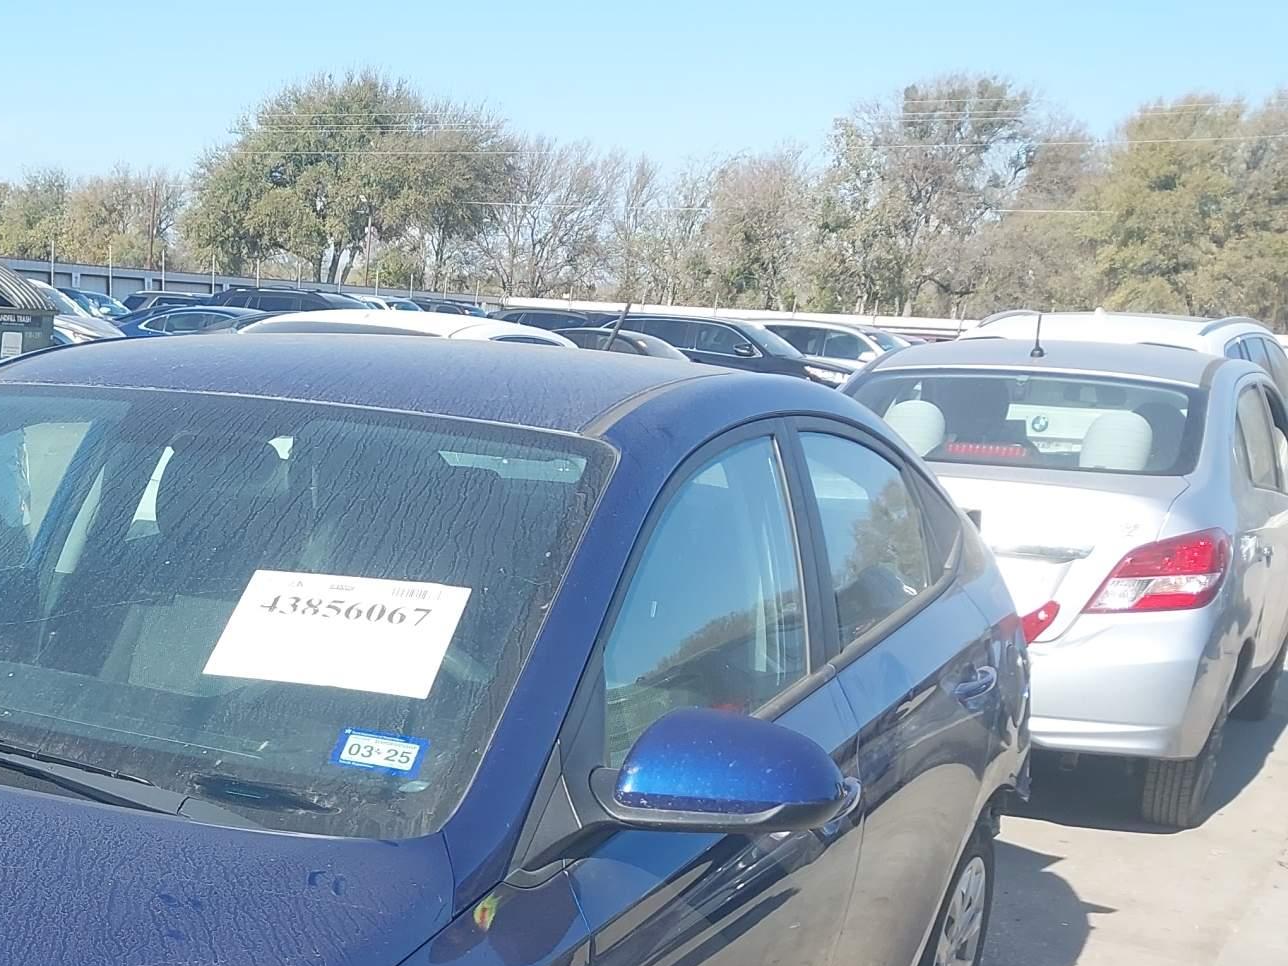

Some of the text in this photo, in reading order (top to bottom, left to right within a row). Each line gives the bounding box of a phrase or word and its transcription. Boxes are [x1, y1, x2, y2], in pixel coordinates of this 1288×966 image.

[260, 594, 433, 627] 43856067
[347, 743, 374, 758] 03
[383, 748, 413, 764] 25
